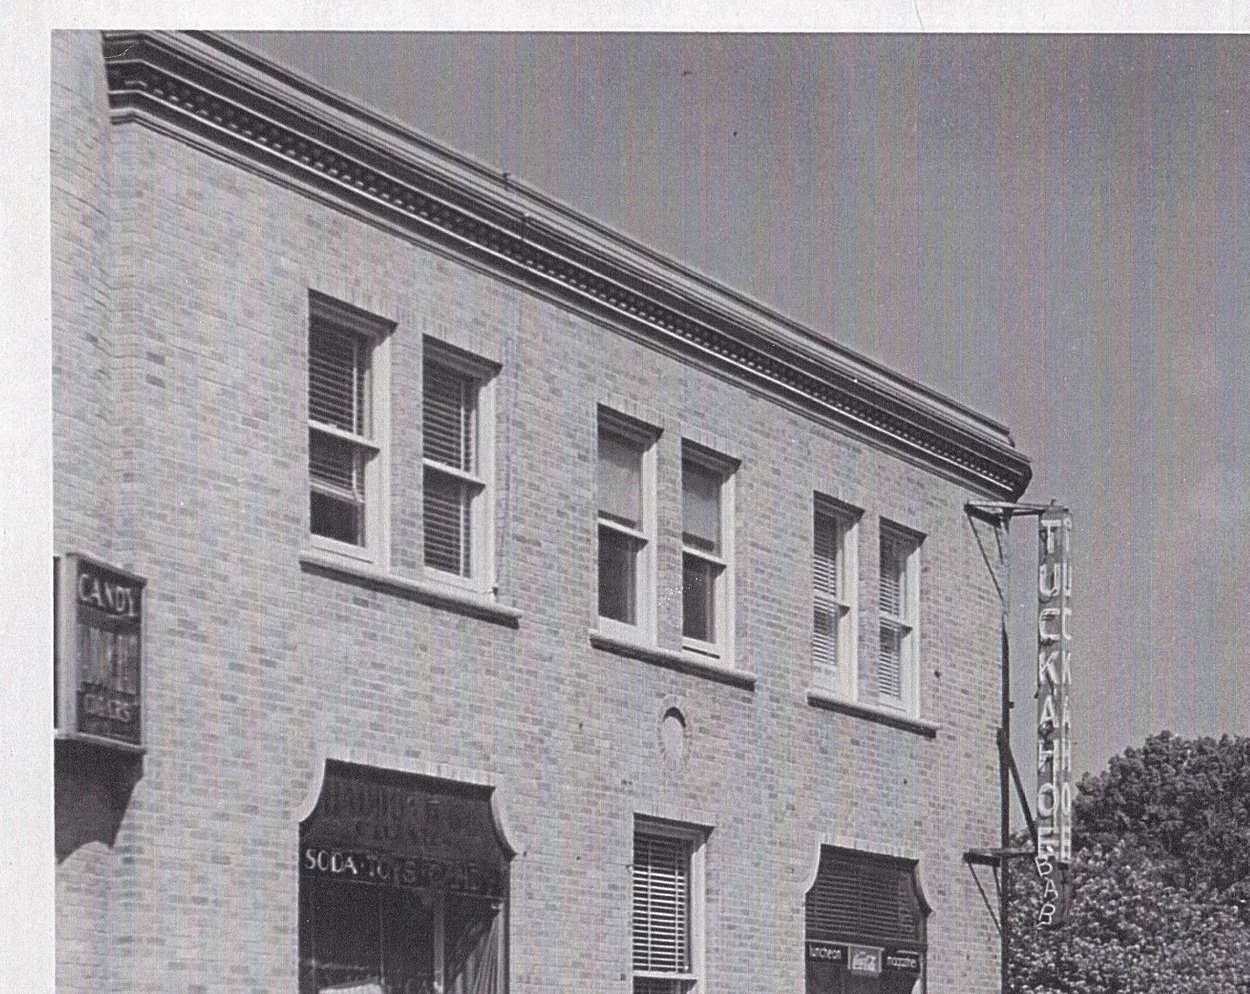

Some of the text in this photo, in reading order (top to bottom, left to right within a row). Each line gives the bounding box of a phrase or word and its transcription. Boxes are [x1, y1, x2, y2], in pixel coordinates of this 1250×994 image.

[77, 573, 134, 617] CANDY
[305, 848, 358, 875] SODA
[1035, 855, 1060, 928] BAR
